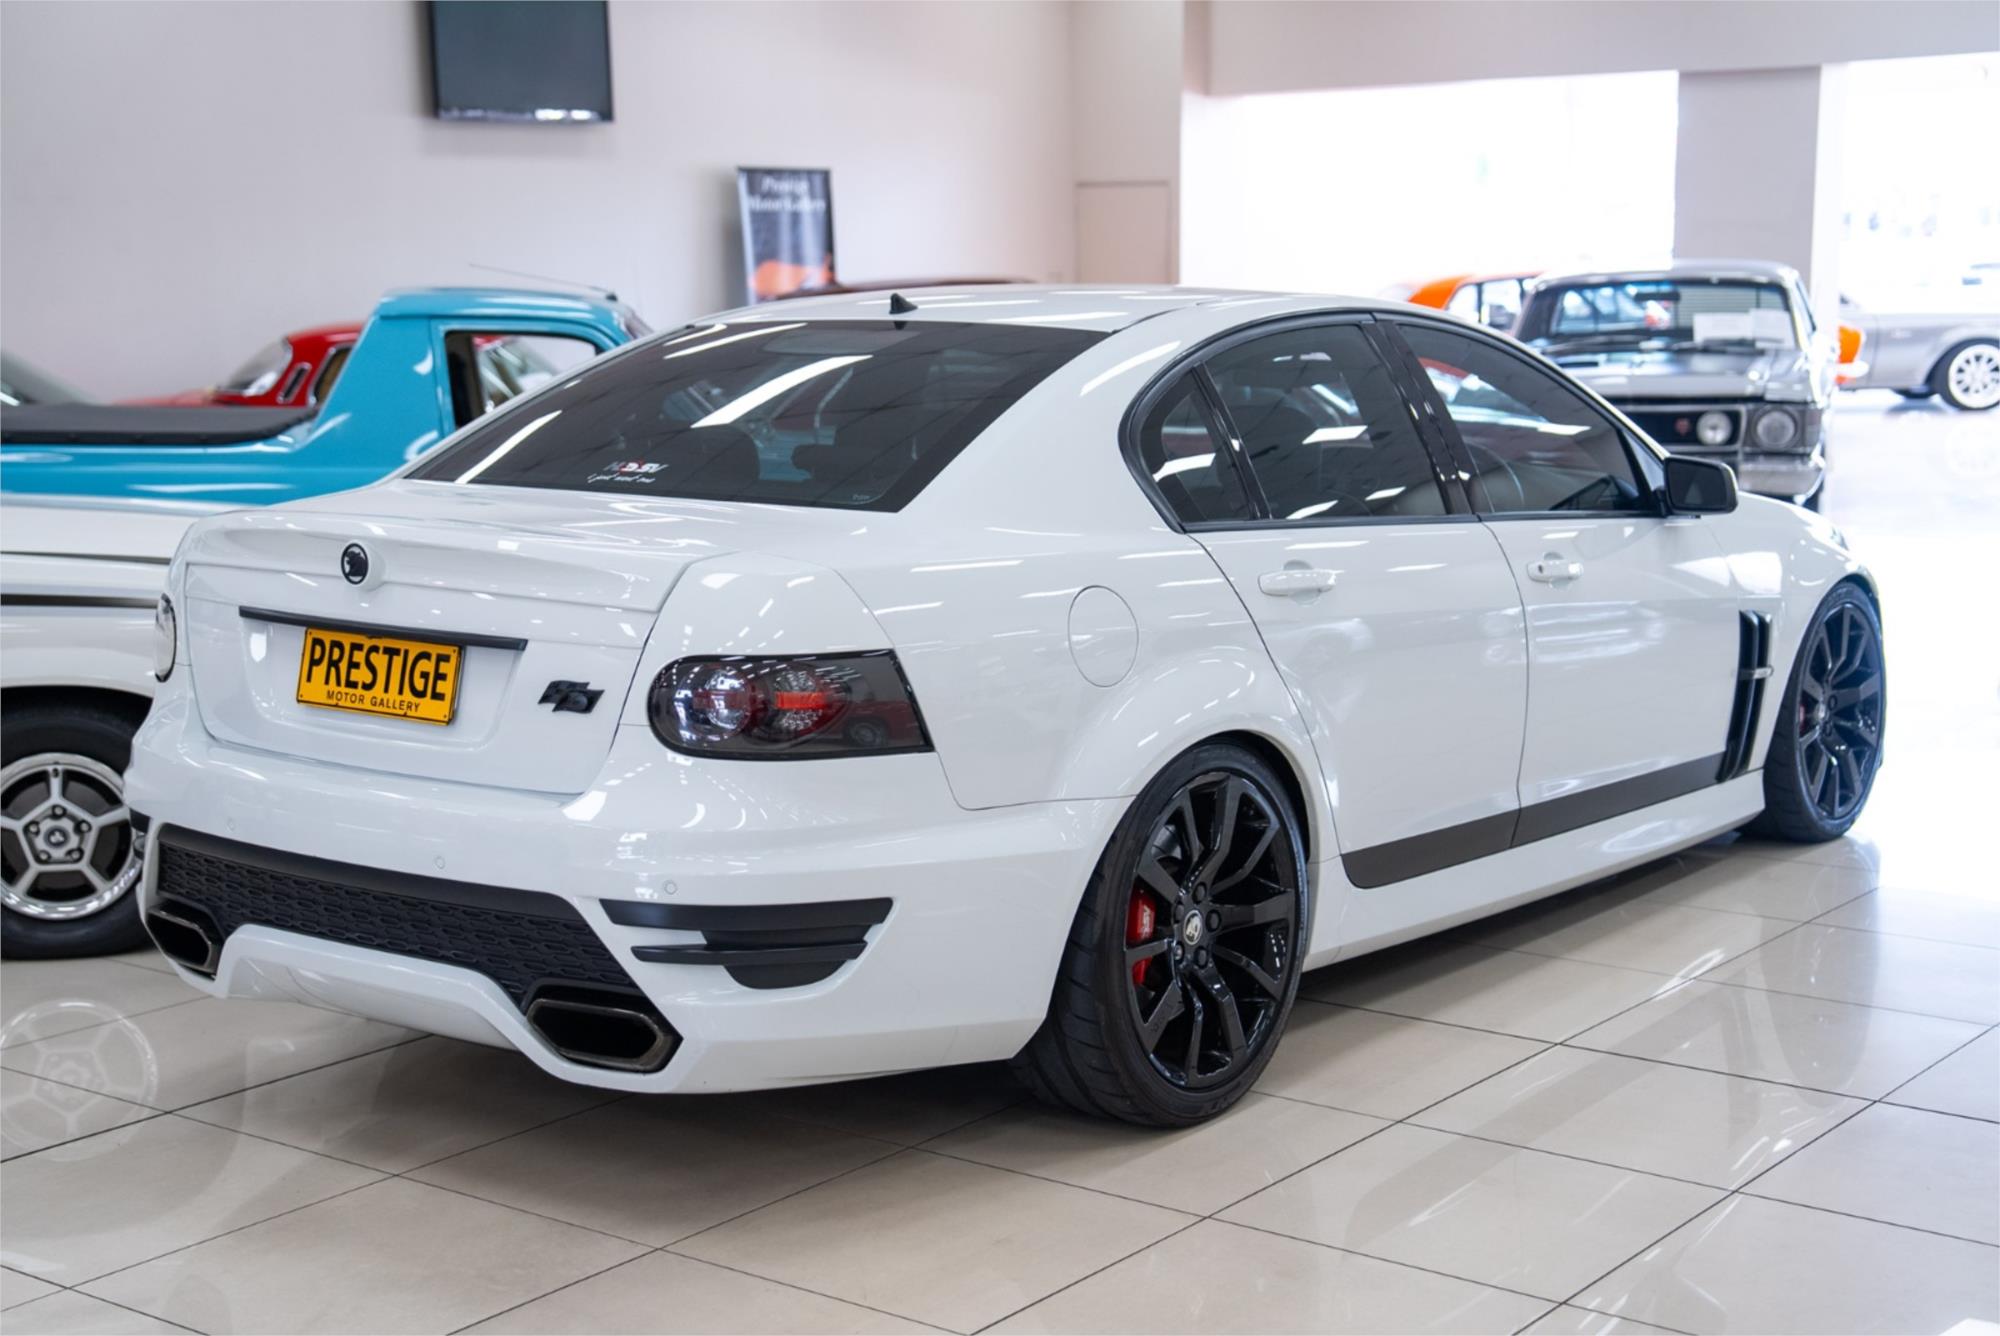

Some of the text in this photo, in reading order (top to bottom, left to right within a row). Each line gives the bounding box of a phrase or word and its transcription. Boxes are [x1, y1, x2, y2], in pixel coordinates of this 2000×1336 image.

[306, 637, 451, 701] PRESTIGE
[326, 689, 421, 713] MOTOR GALLERY
